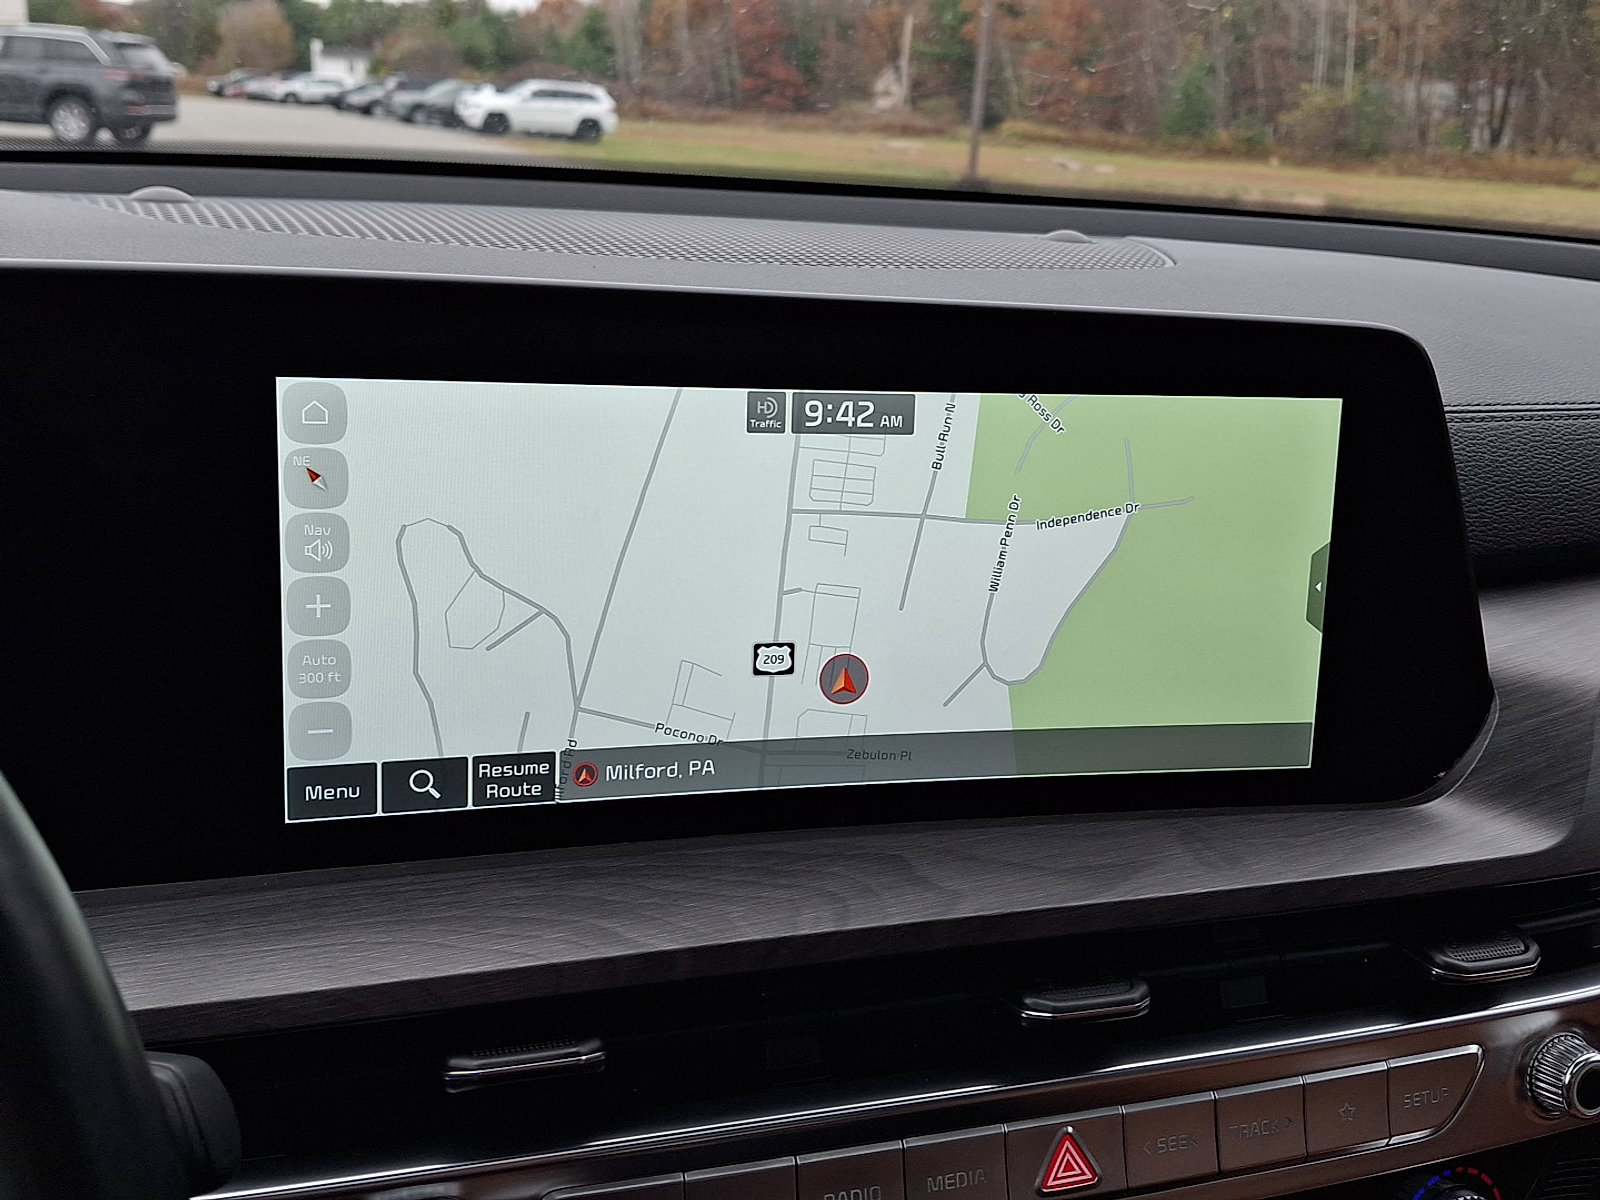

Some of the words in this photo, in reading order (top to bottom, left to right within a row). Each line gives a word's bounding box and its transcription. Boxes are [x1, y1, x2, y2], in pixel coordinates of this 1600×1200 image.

[804, 400, 875, 428] 9:42
[880, 415, 903, 428] AM
[944, 403, 956, 413] N
[1027, 394, 1052, 421] Ross
[1051, 418, 1065, 433] Dr
[750, 419, 782, 429] Traffic
[938, 416, 953, 442] Run
[293, 456, 310, 467] NE
[931, 445, 947, 470] Bull
[1036, 506, 1122, 531] Independence
[1125, 503, 1140, 514] Dr
[304, 524, 331, 536] Nav
[988, 551, 1008, 593] William
[1000, 515, 1017, 547] Penn
[1009, 495, 1021, 511] Dr
[302, 655, 337, 666] Auto
[763, 654, 785, 665] 209
[299, 672, 324, 684] 300
[328, 672, 341, 683] ft
[655, 722, 704, 743] Pocono
[708, 734, 724, 746] Dr
[846, 748, 897, 760] Zebulon
[900, 750, 912, 761] Pl
[478, 763, 550, 778] Resume
[689, 759, 715, 776] PA
[305, 785, 360, 801] Menu
[486, 781, 542, 799] Route
[1403, 1087, 1449, 1109] SETUP
[1229, 1119, 1280, 1141] TRACK
[927, 1168, 986, 1193] MEDIA
